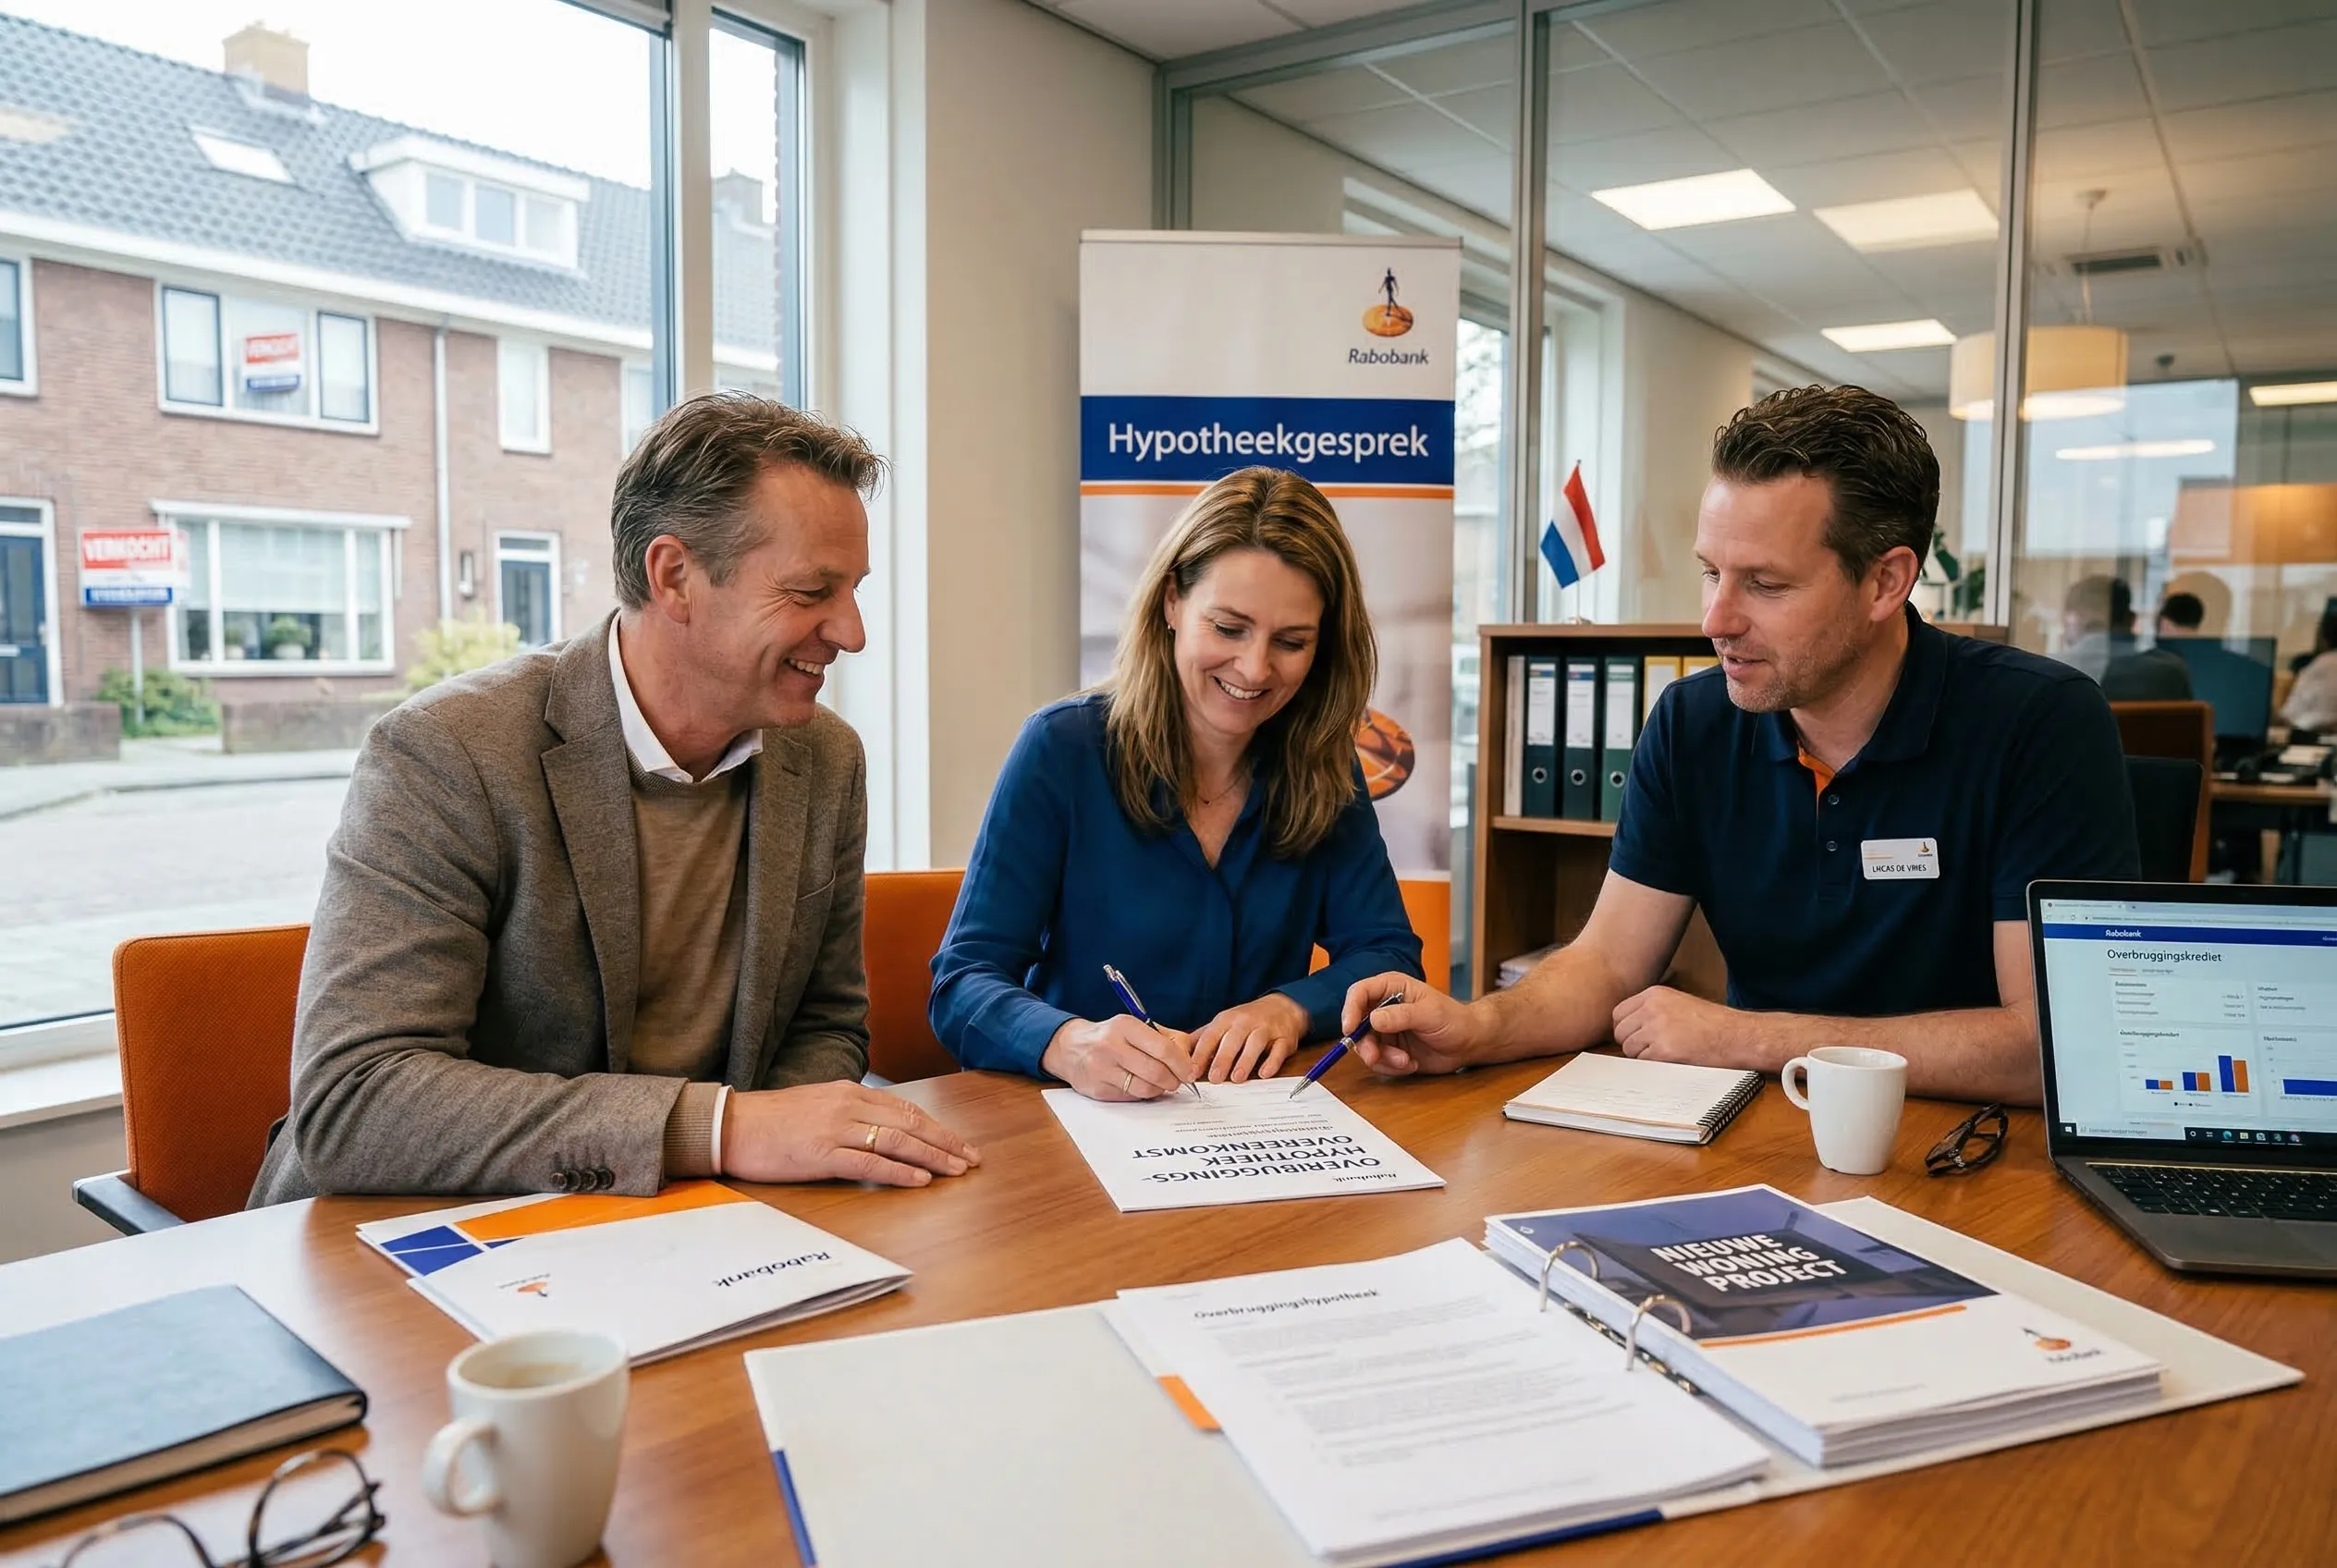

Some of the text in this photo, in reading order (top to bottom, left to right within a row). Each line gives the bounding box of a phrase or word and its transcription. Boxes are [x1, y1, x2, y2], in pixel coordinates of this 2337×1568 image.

[1348, 348, 1429, 364] Rabobank
[1108, 423, 1429, 463] Hypotheekgesprek
[1906, 864, 1927, 872] VRIES
[2107, 949, 2222, 962] Overbruggingskrediet
[1132, 1135, 1353, 1158] OVEREENKOMST
[1201, 1145, 1366, 1166] HYPOTHEEK
[1650, 1234, 1782, 1262] NIEUWE
[713, 1252, 832, 1287] Rabobank
[1672, 1246, 1819, 1277] WONING
[1703, 1260, 1847, 1292] PROJECT
